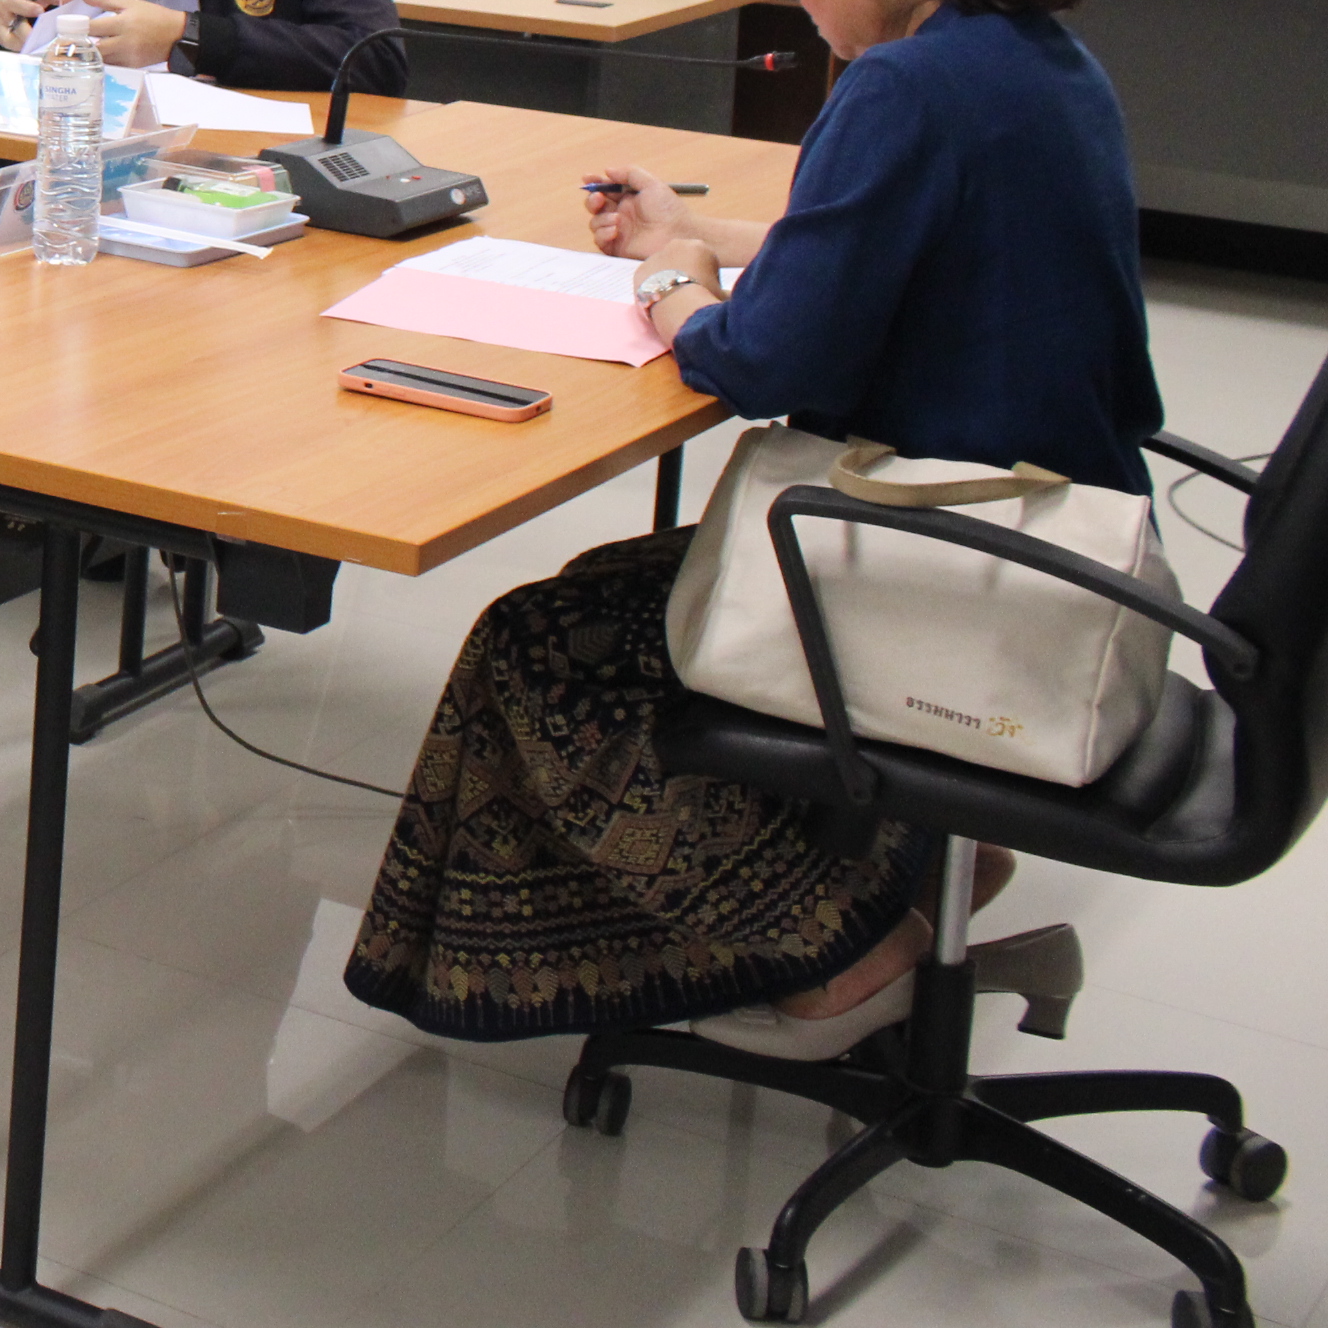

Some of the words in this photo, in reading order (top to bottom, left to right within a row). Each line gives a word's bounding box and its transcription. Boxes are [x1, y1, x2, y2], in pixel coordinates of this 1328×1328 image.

[44, 84, 78, 95] SINGHA
[905, 695, 982, 730] ธรรมนาวา
